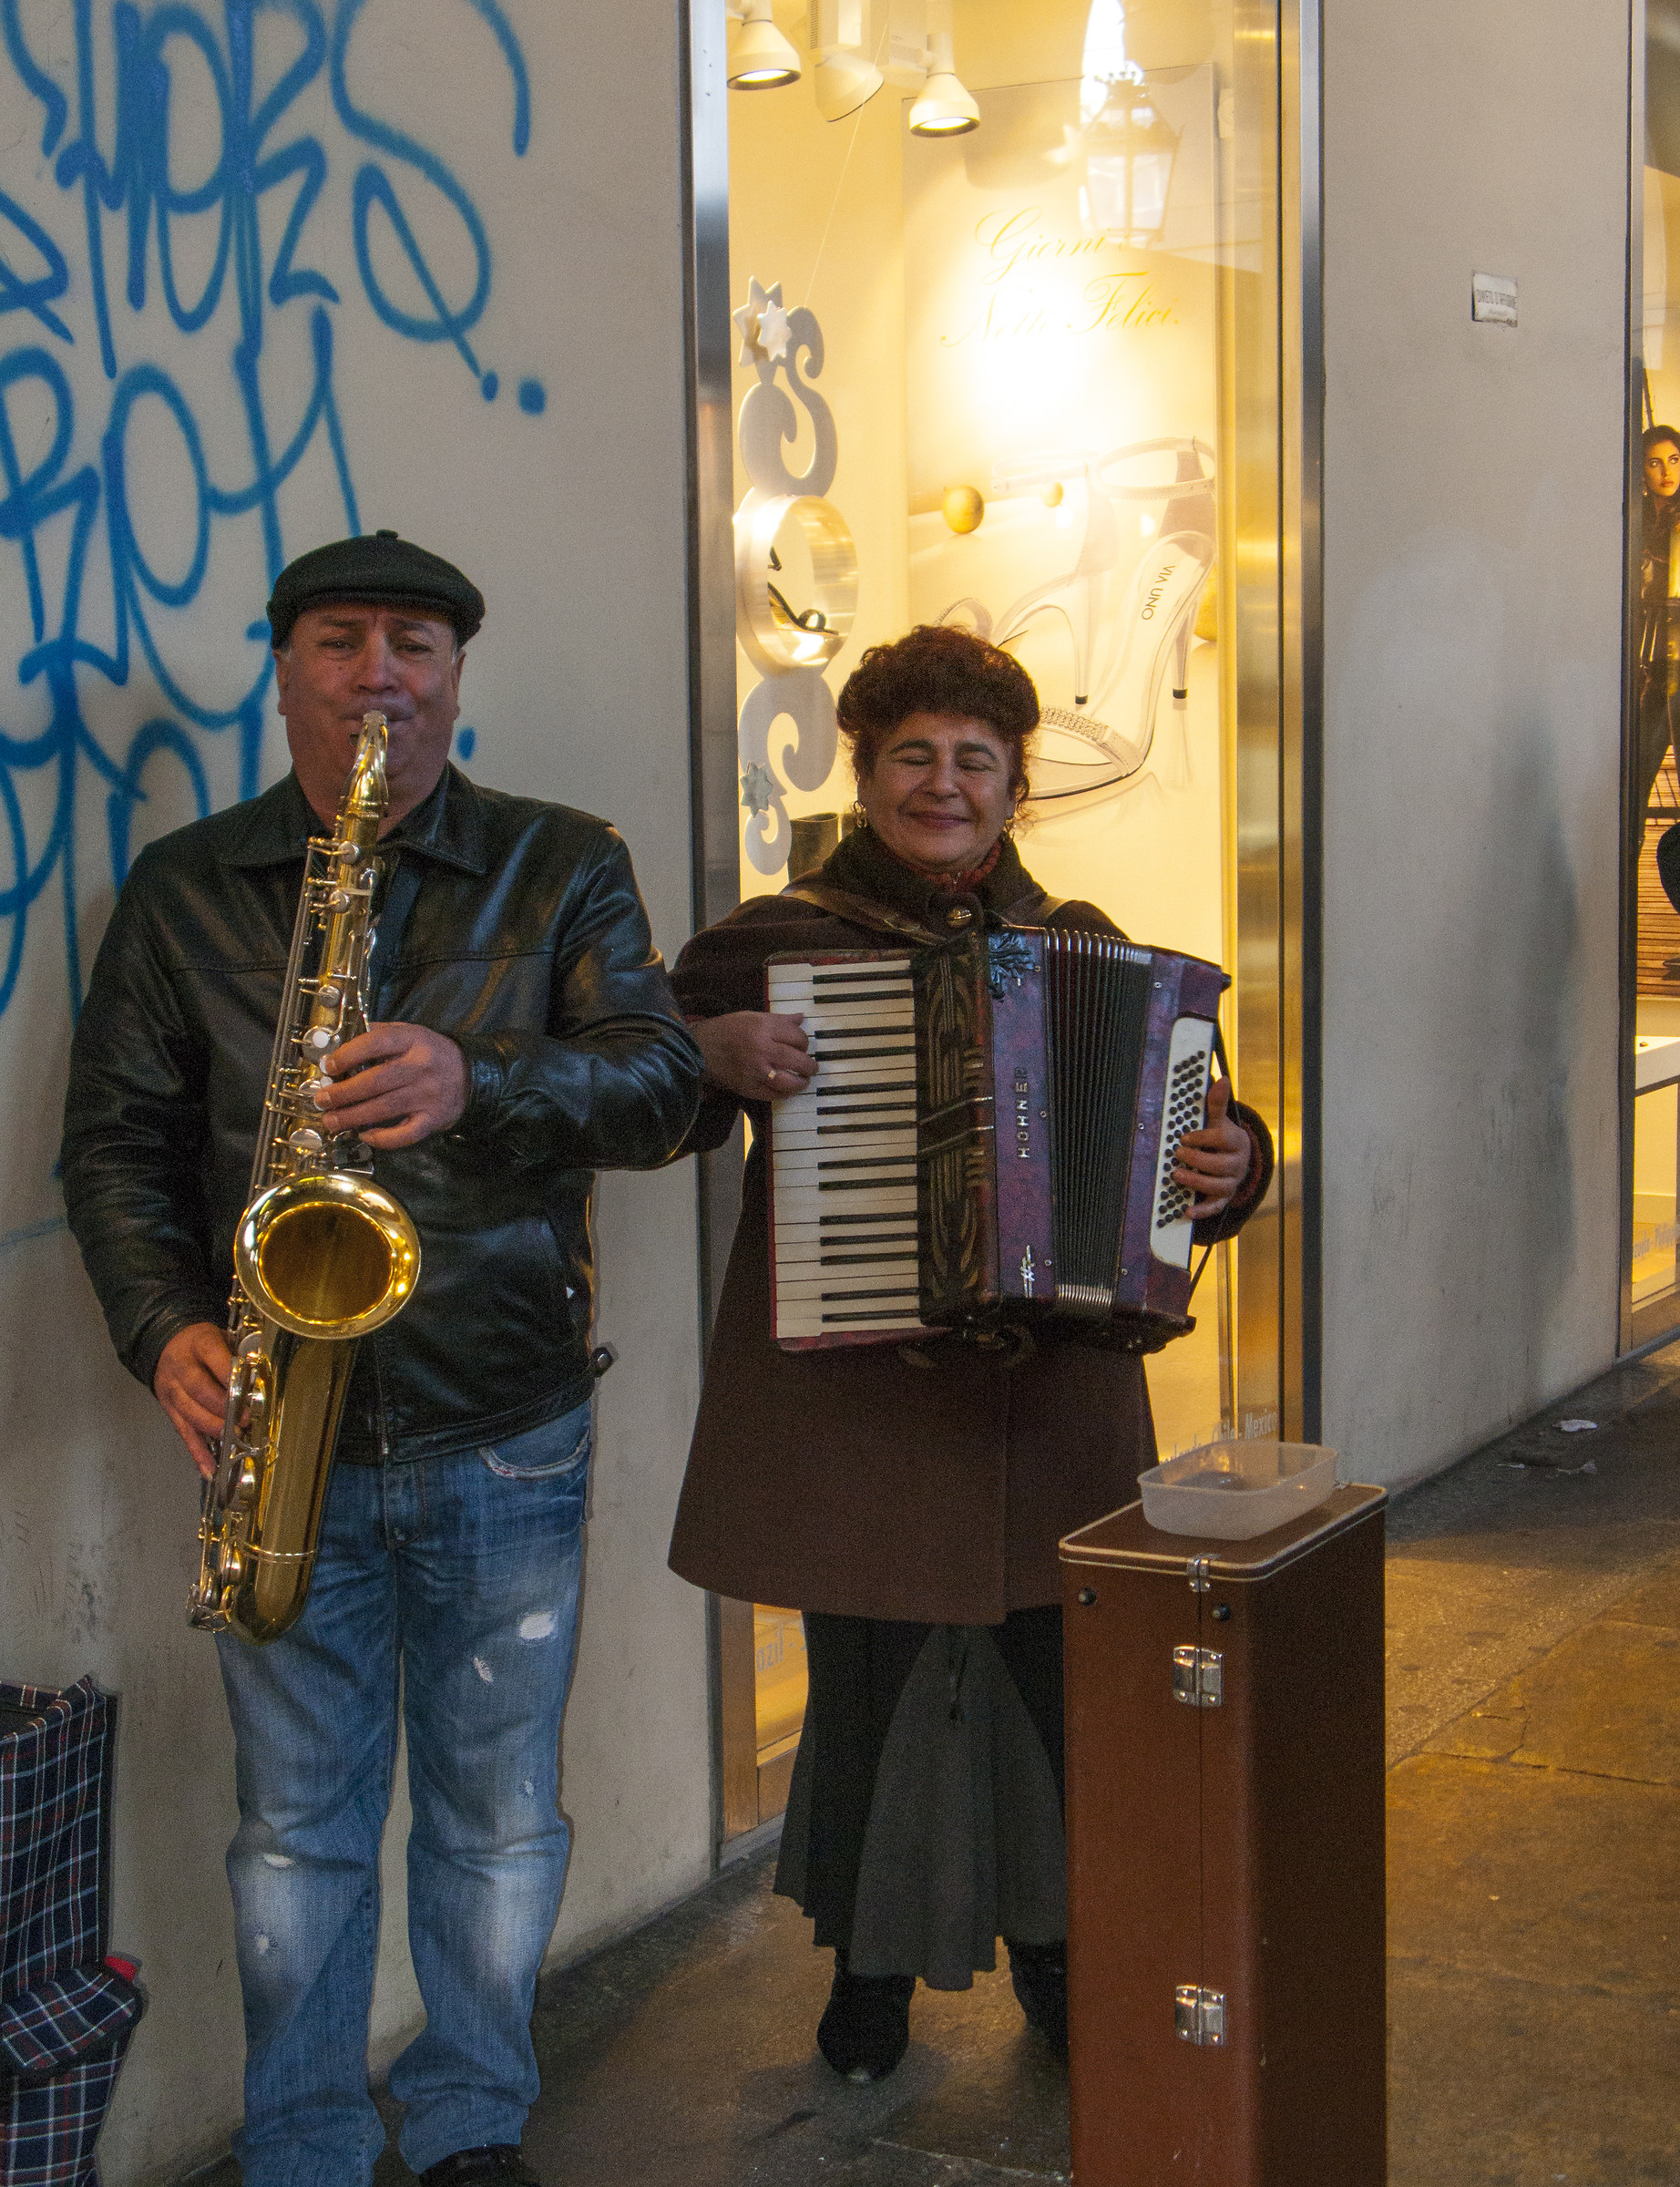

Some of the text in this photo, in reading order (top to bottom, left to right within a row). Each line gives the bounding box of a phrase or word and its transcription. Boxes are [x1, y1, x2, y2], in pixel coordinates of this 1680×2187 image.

[1142, 565, 1175, 620] VIA UNO
[1015, 1066, 1030, 1158] HOHNER
[756, 1625, 784, 1672] azil
